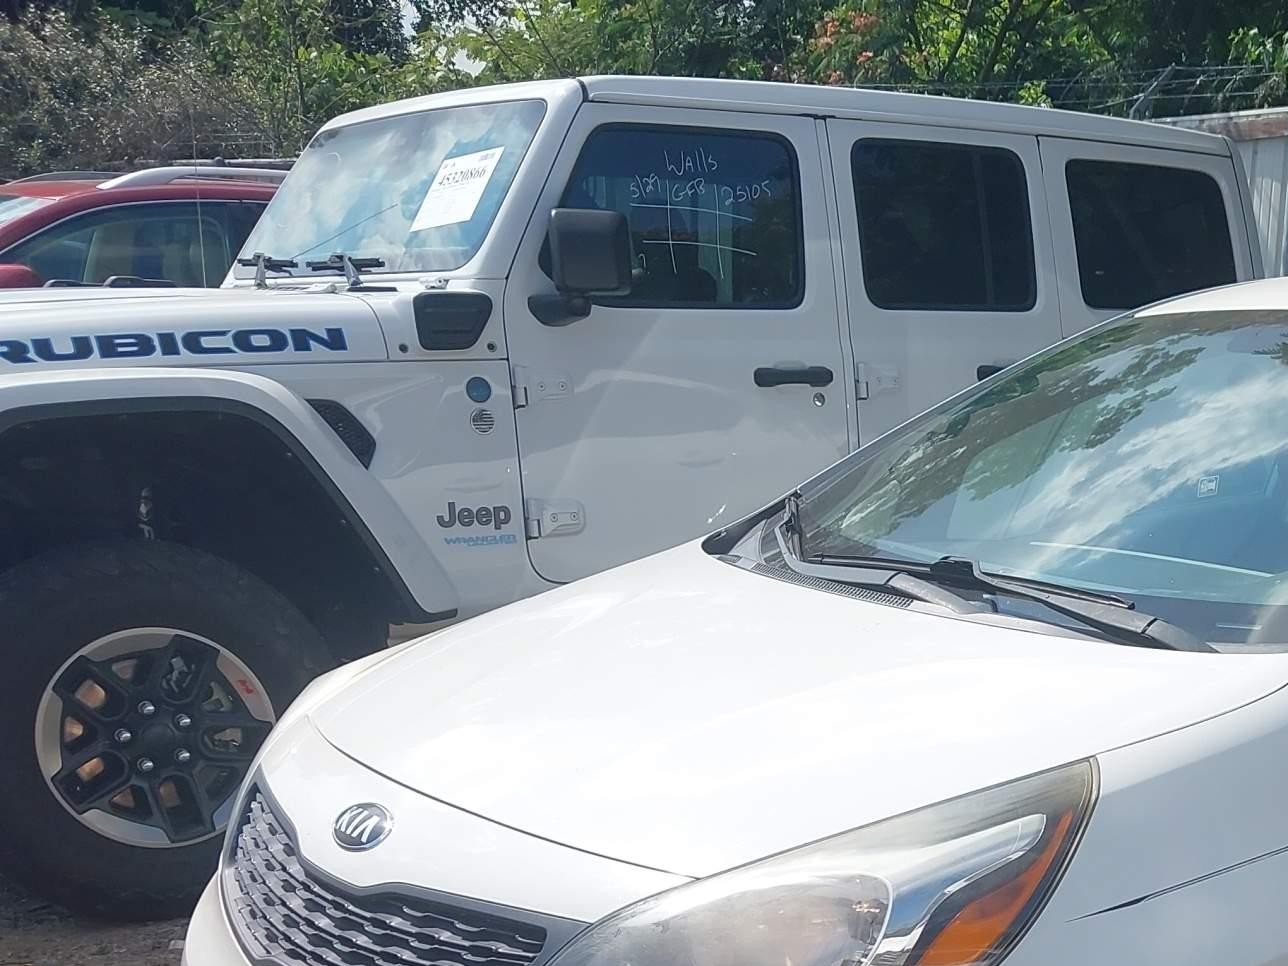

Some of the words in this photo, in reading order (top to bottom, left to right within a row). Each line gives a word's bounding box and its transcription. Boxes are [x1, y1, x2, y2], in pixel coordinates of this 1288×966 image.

[0, 327, 349, 364] RUBICON
[436, 501, 512, 531] Jeep
[335, 805, 381, 844] KIA
